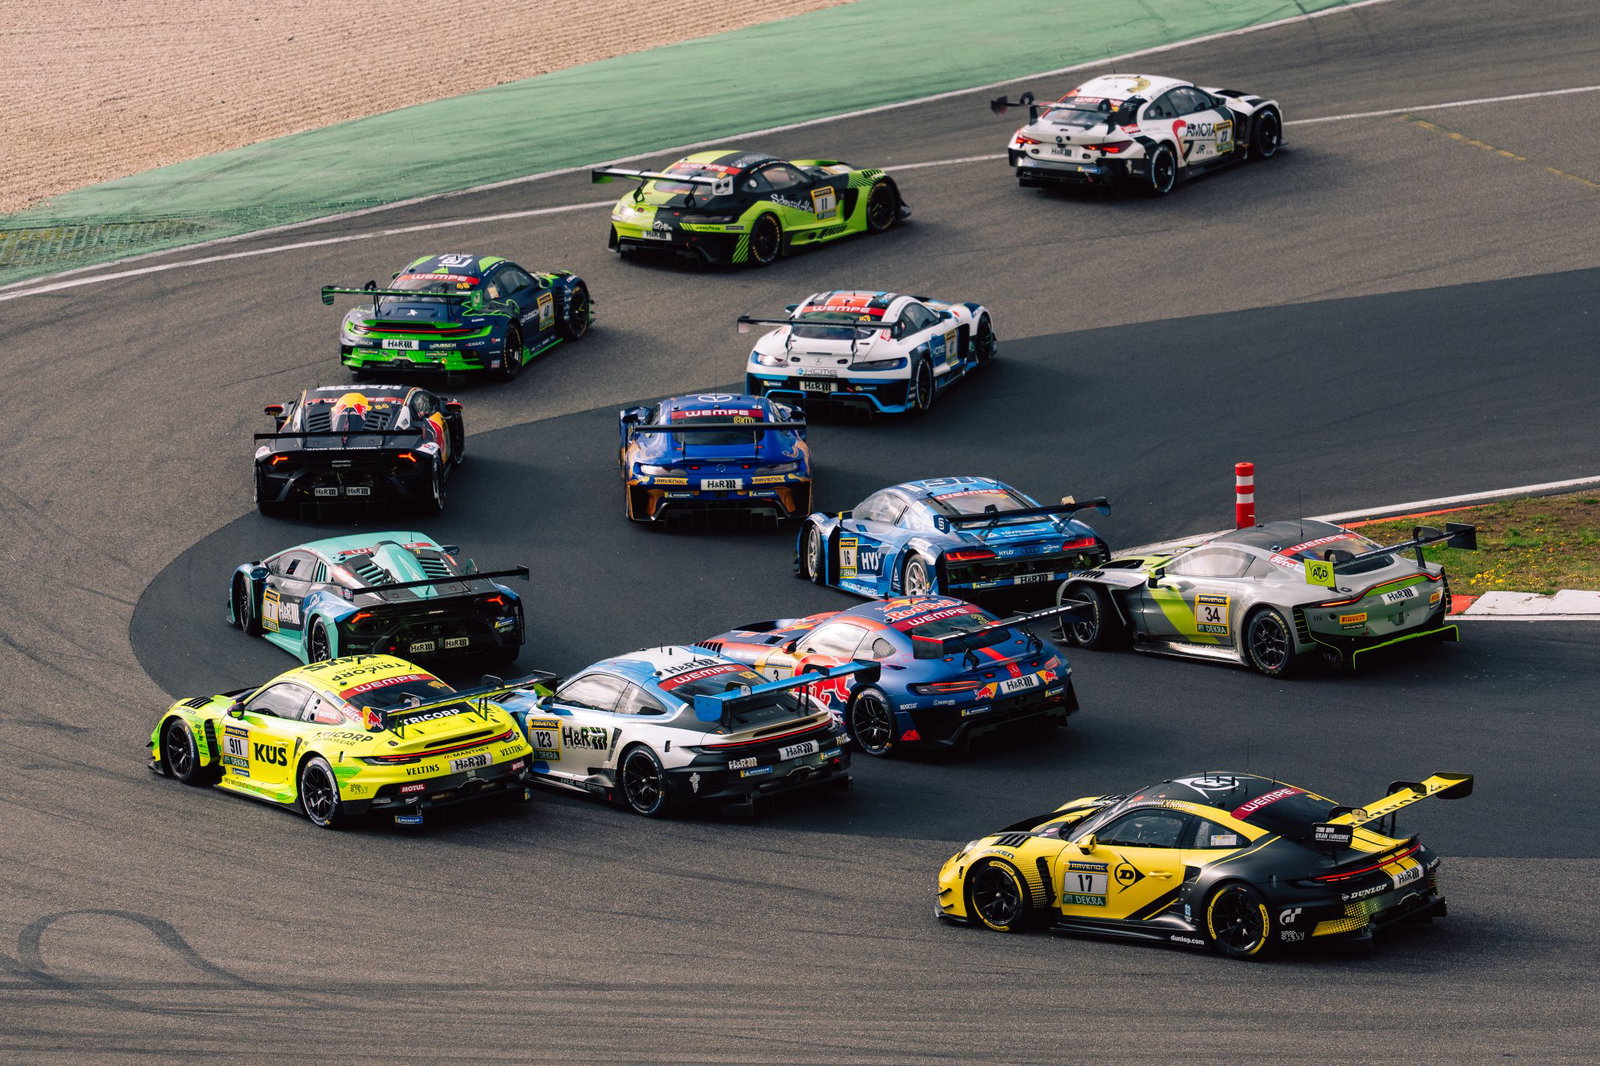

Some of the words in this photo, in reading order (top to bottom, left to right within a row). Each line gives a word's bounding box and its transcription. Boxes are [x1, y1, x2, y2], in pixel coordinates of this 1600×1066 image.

[821, 198, 828, 210] 11
[411, 273, 468, 281] WEMPE
[812, 305, 871, 313] WEMPE
[388, 340, 404, 348] H&R
[804, 382, 821, 390] H&R
[685, 409, 749, 417] WEMPE
[936, 489, 998, 500] WEMPE
[1290, 534, 1349, 552] WEMPE
[843, 550, 851, 565] 16
[1387, 591, 1404, 601] H&R
[269, 603, 273, 617] 7
[1205, 607, 1220, 622] 34
[907, 608, 969, 626] WEMPE
[1341, 615, 1365, 623] PIRELLI
[1206, 625, 1226, 633] DEKRA
[665, 662, 698, 674] H&R
[673, 665, 737, 684] WEMPE
[353, 674, 421, 692] WEMPE
[1006, 680, 1024, 690] H&R
[400, 708, 460, 725] TRICORP
[316, 731, 374, 742] TRICORP
[536, 732, 552, 748] 123
[562, 727, 591, 749] H&R
[229, 738, 242, 755] 911
[453, 747, 489, 758] MANTHEY
[499, 744, 523, 757] VELTINS
[786, 746, 804, 757] H&R
[253, 742, 288, 766] KÜS
[540, 751, 558, 759] DEKRA
[406, 764, 440, 776] VELTINS
[455, 759, 476, 770] H&R
[728, 759, 747, 770] H&R
[1241, 788, 1296, 812] WEMPE
[1077, 874, 1093, 892] 17
[1398, 871, 1414, 884] H&R
[1350, 884, 1388, 899] DUNLOP
[1075, 896, 1104, 906] DEKRA
[1170, 934, 1205, 945] dunlop.com
